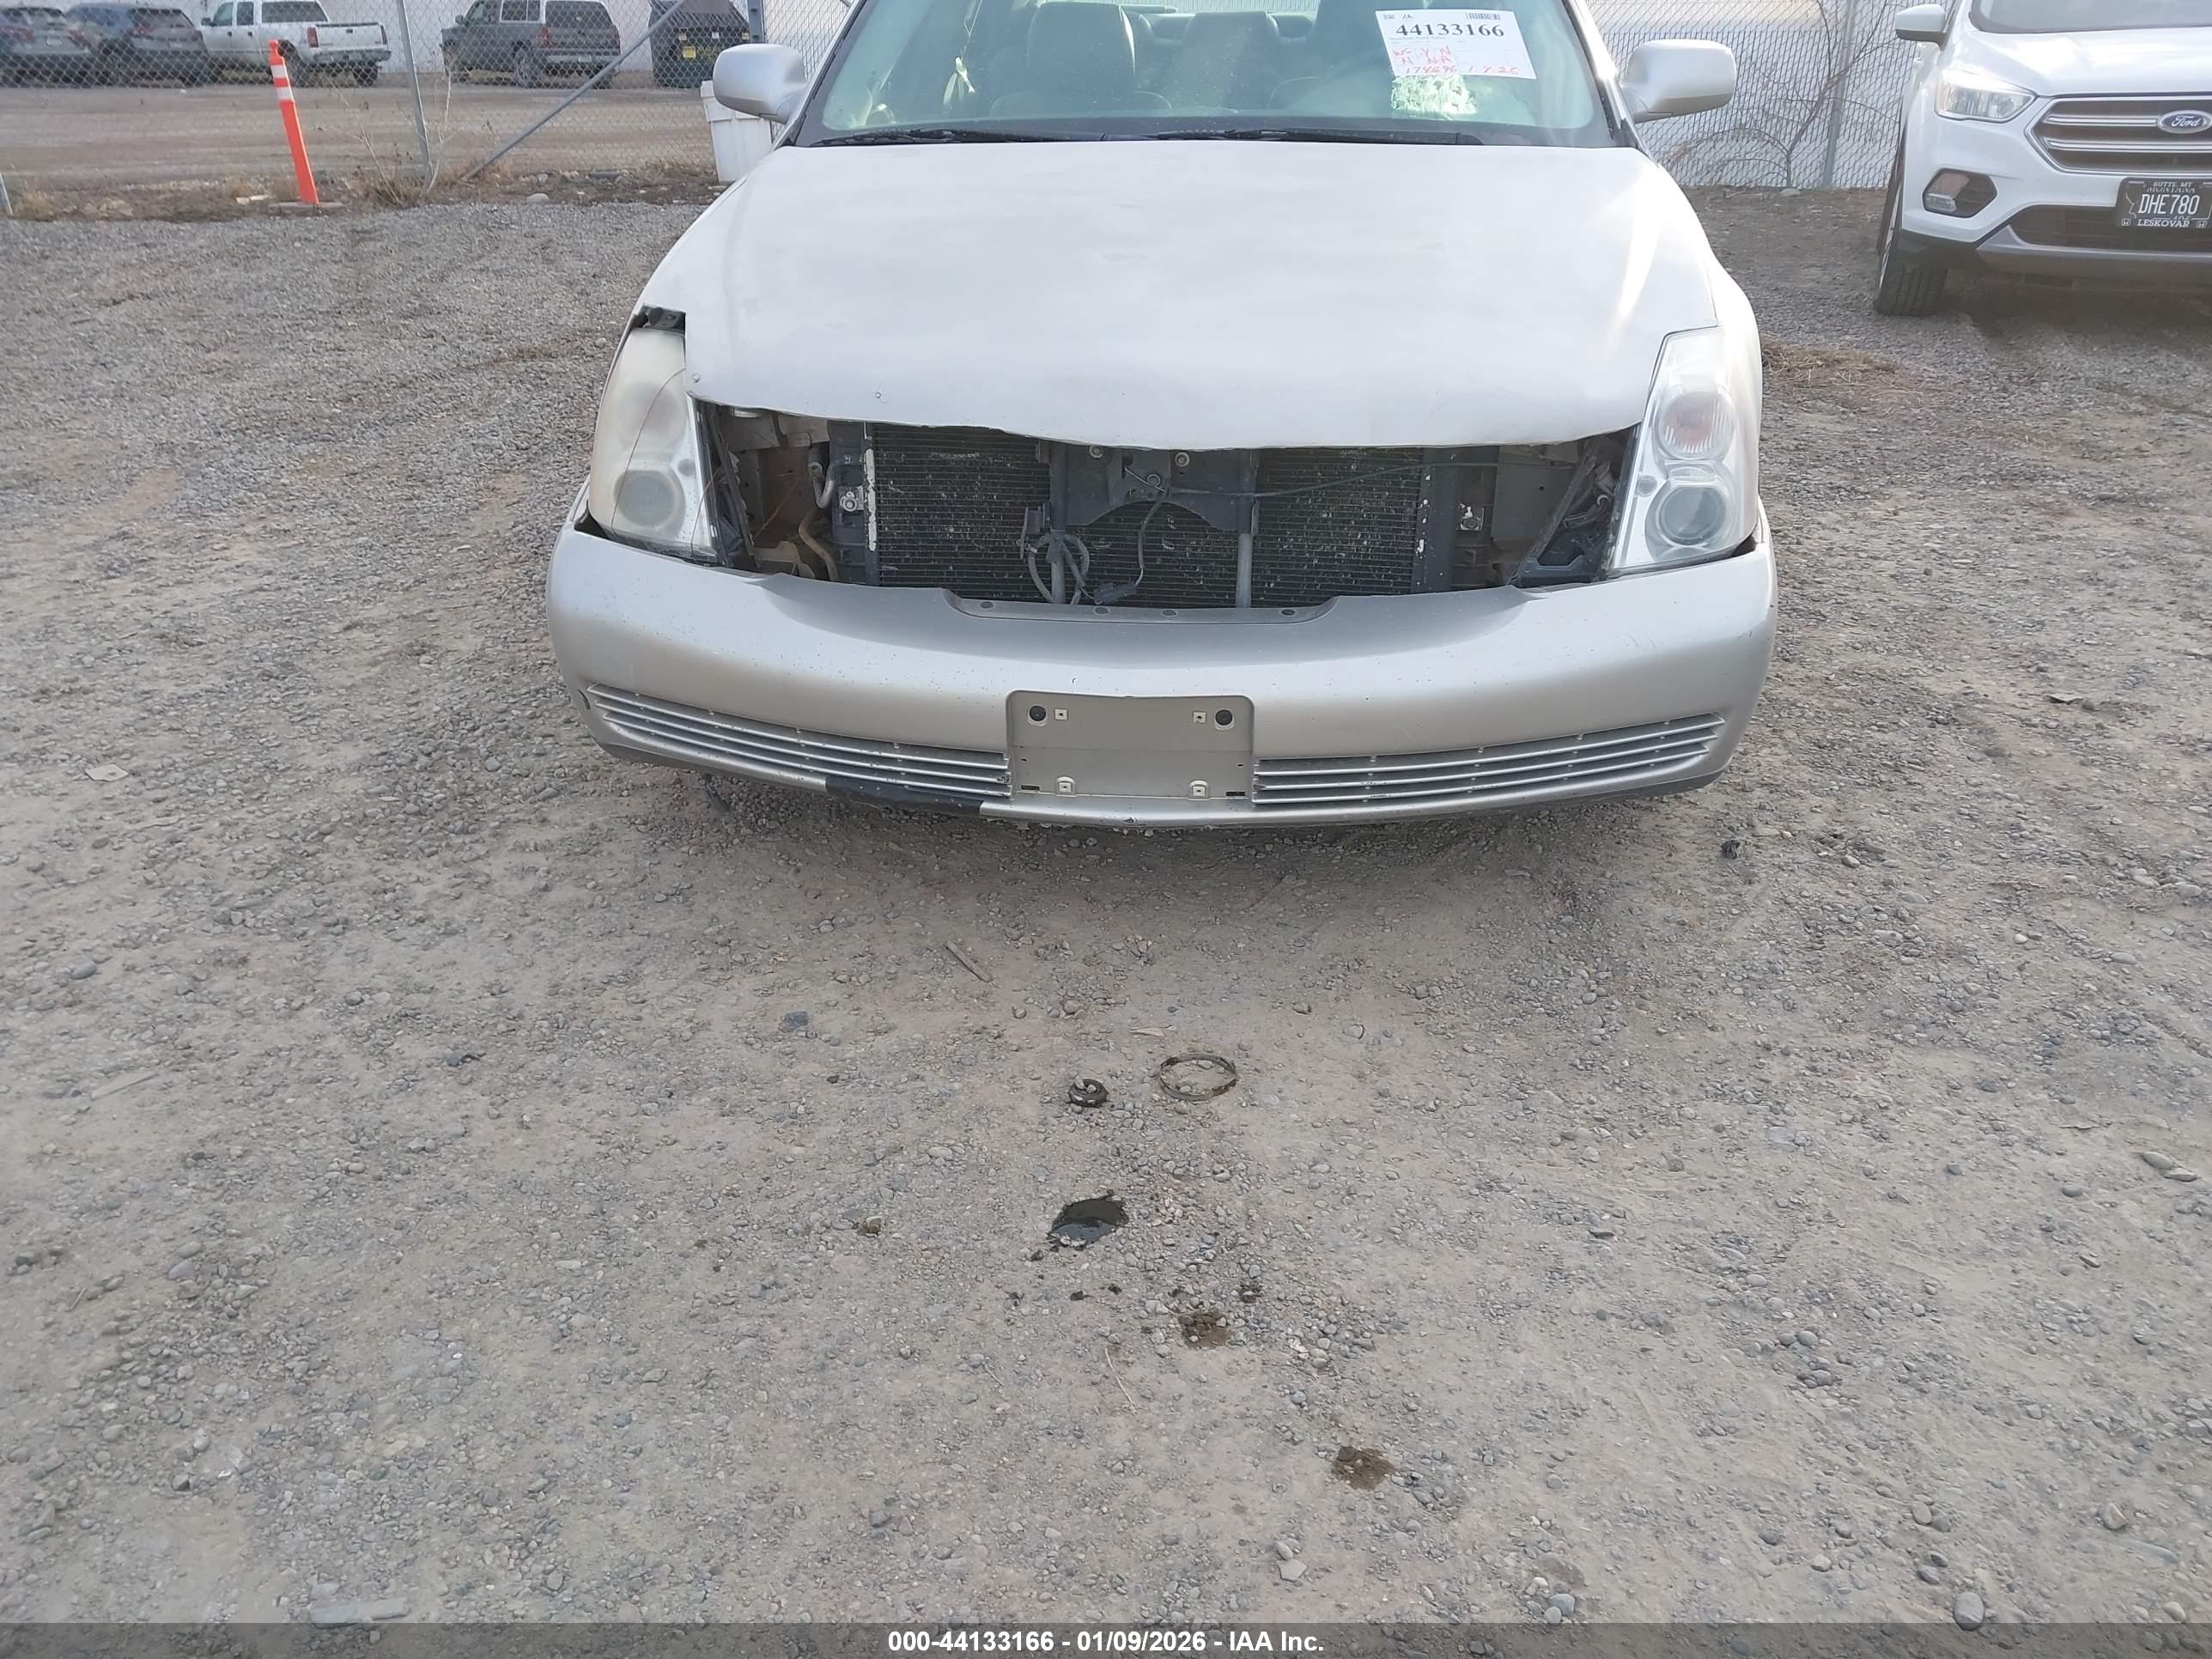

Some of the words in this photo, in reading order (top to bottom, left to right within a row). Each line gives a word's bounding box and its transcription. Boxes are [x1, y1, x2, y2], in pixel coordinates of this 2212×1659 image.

[1395, 23, 1504, 37] 44133166
[2171, 115, 2202, 127] Ford
[2137, 193, 2201, 216] DHE780
[2136, 219, 2191, 228] LESKOVAR
